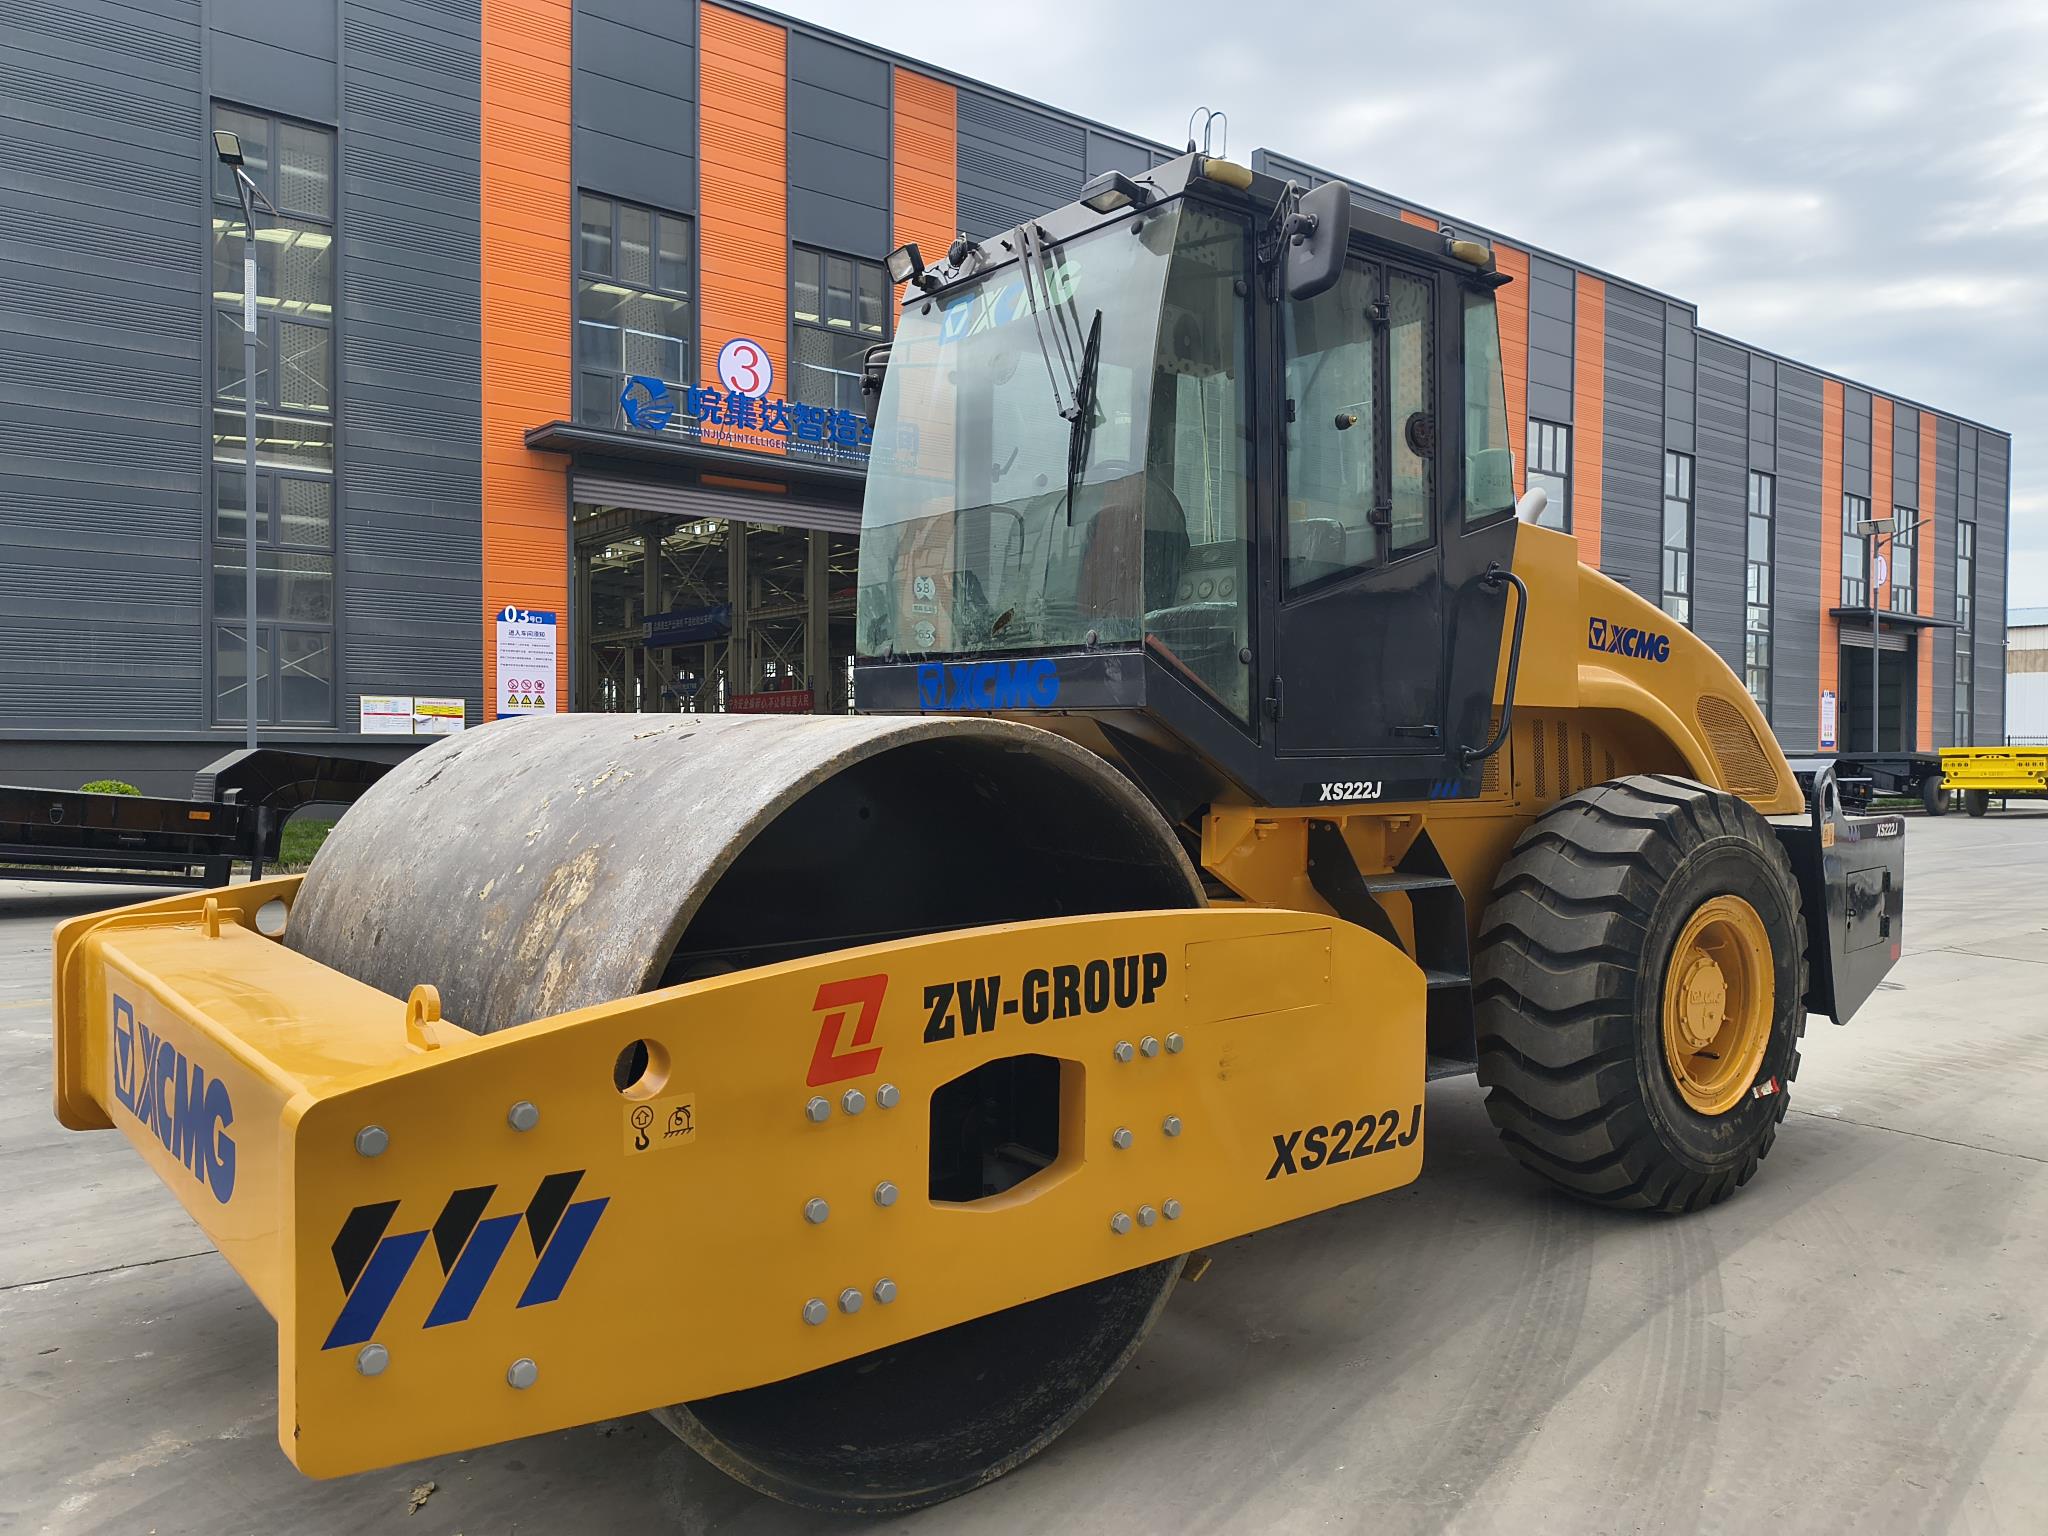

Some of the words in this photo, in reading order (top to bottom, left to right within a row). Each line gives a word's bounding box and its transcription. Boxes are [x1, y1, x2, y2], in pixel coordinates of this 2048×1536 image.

[730, 344, 761, 393] 3
[1607, 624, 1671, 663] XCMG
[951, 659, 1060, 709] XCMG
[1320, 781, 1383, 801] XS222J
[1876, 822, 1899, 837] XS222J
[922, 951, 1168, 1045] ZW-GROUP
[136, 1021, 236, 1204] XCMG
[1265, 1104, 1423, 1181] XS222J
